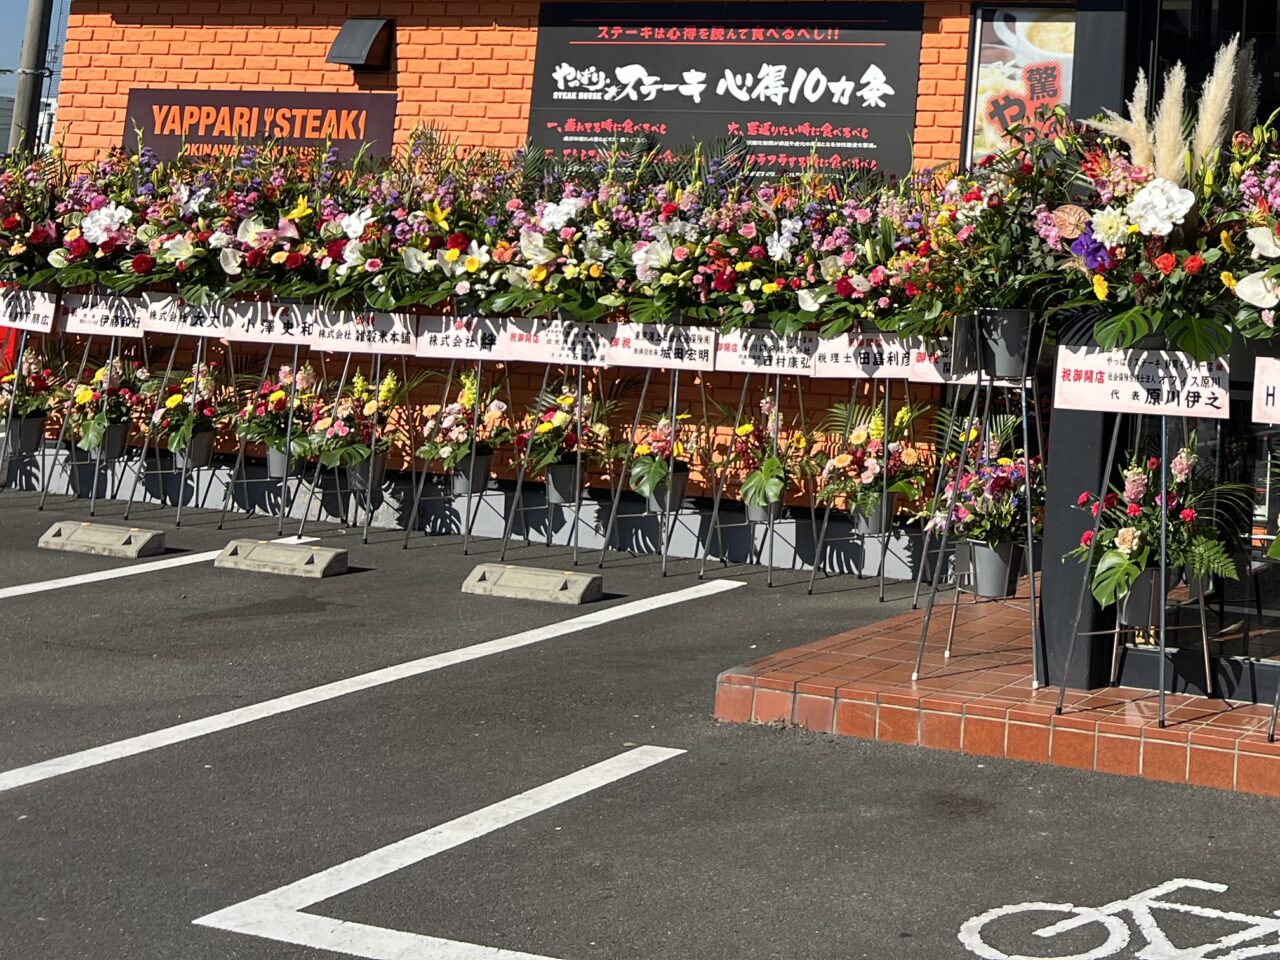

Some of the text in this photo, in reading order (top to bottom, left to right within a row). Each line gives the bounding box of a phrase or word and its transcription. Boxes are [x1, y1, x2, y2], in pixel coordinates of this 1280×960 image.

[152, 104, 259, 138] YAPPARI
[318, 328, 352, 340] 株式会社
[428, 334, 475, 348] 株式会社
[817, 352, 853, 364] 税理士
[1060, 367, 1106, 385] 祝御開店
[1110, 389, 1140, 402] 代表
